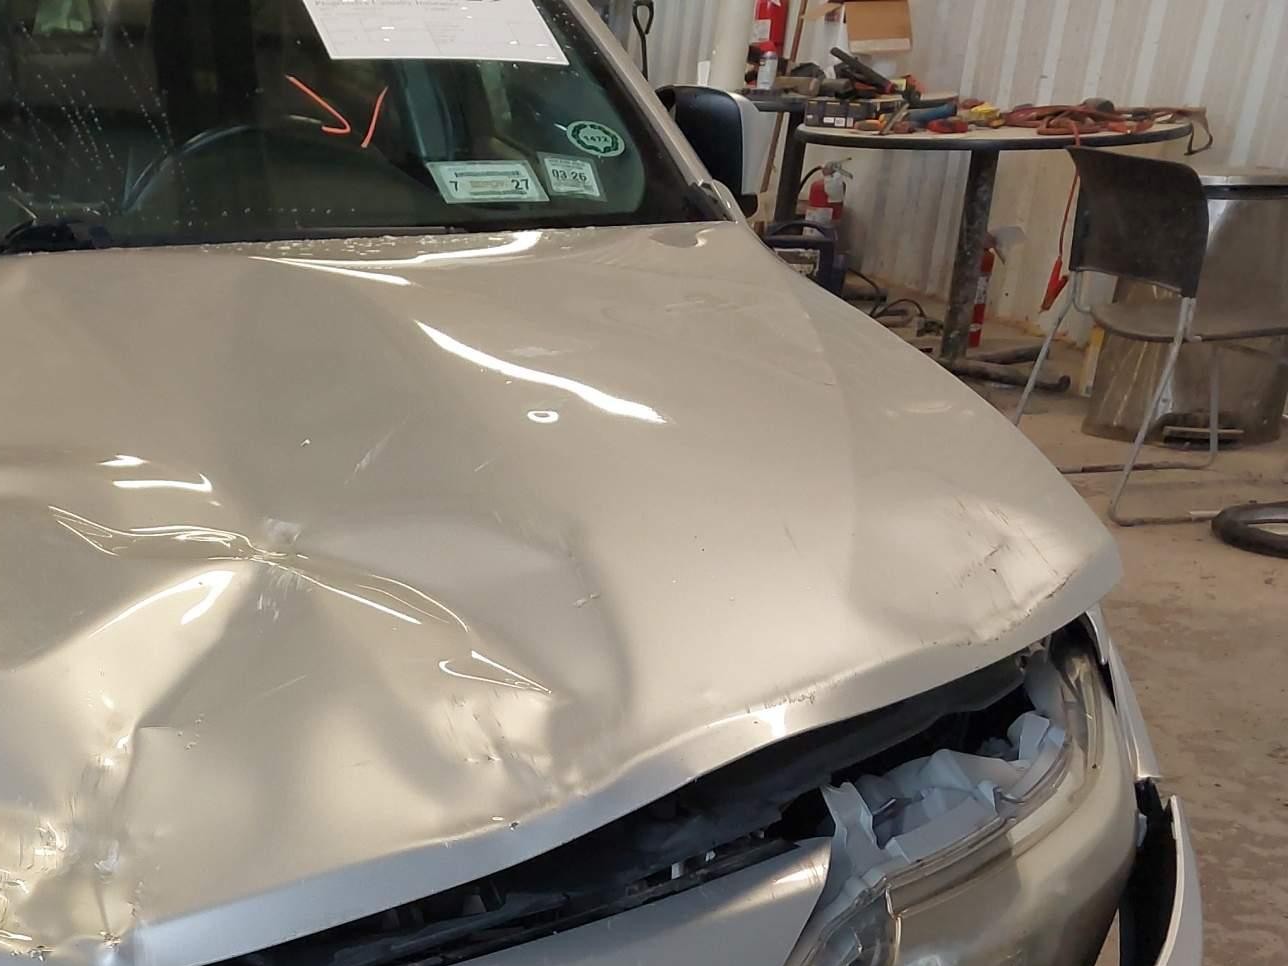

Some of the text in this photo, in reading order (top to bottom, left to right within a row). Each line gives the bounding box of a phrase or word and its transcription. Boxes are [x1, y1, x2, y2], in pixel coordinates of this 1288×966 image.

[551, 168, 588, 182] 03 26
[449, 180, 459, 193] 7
[511, 179, 530, 191] 27
